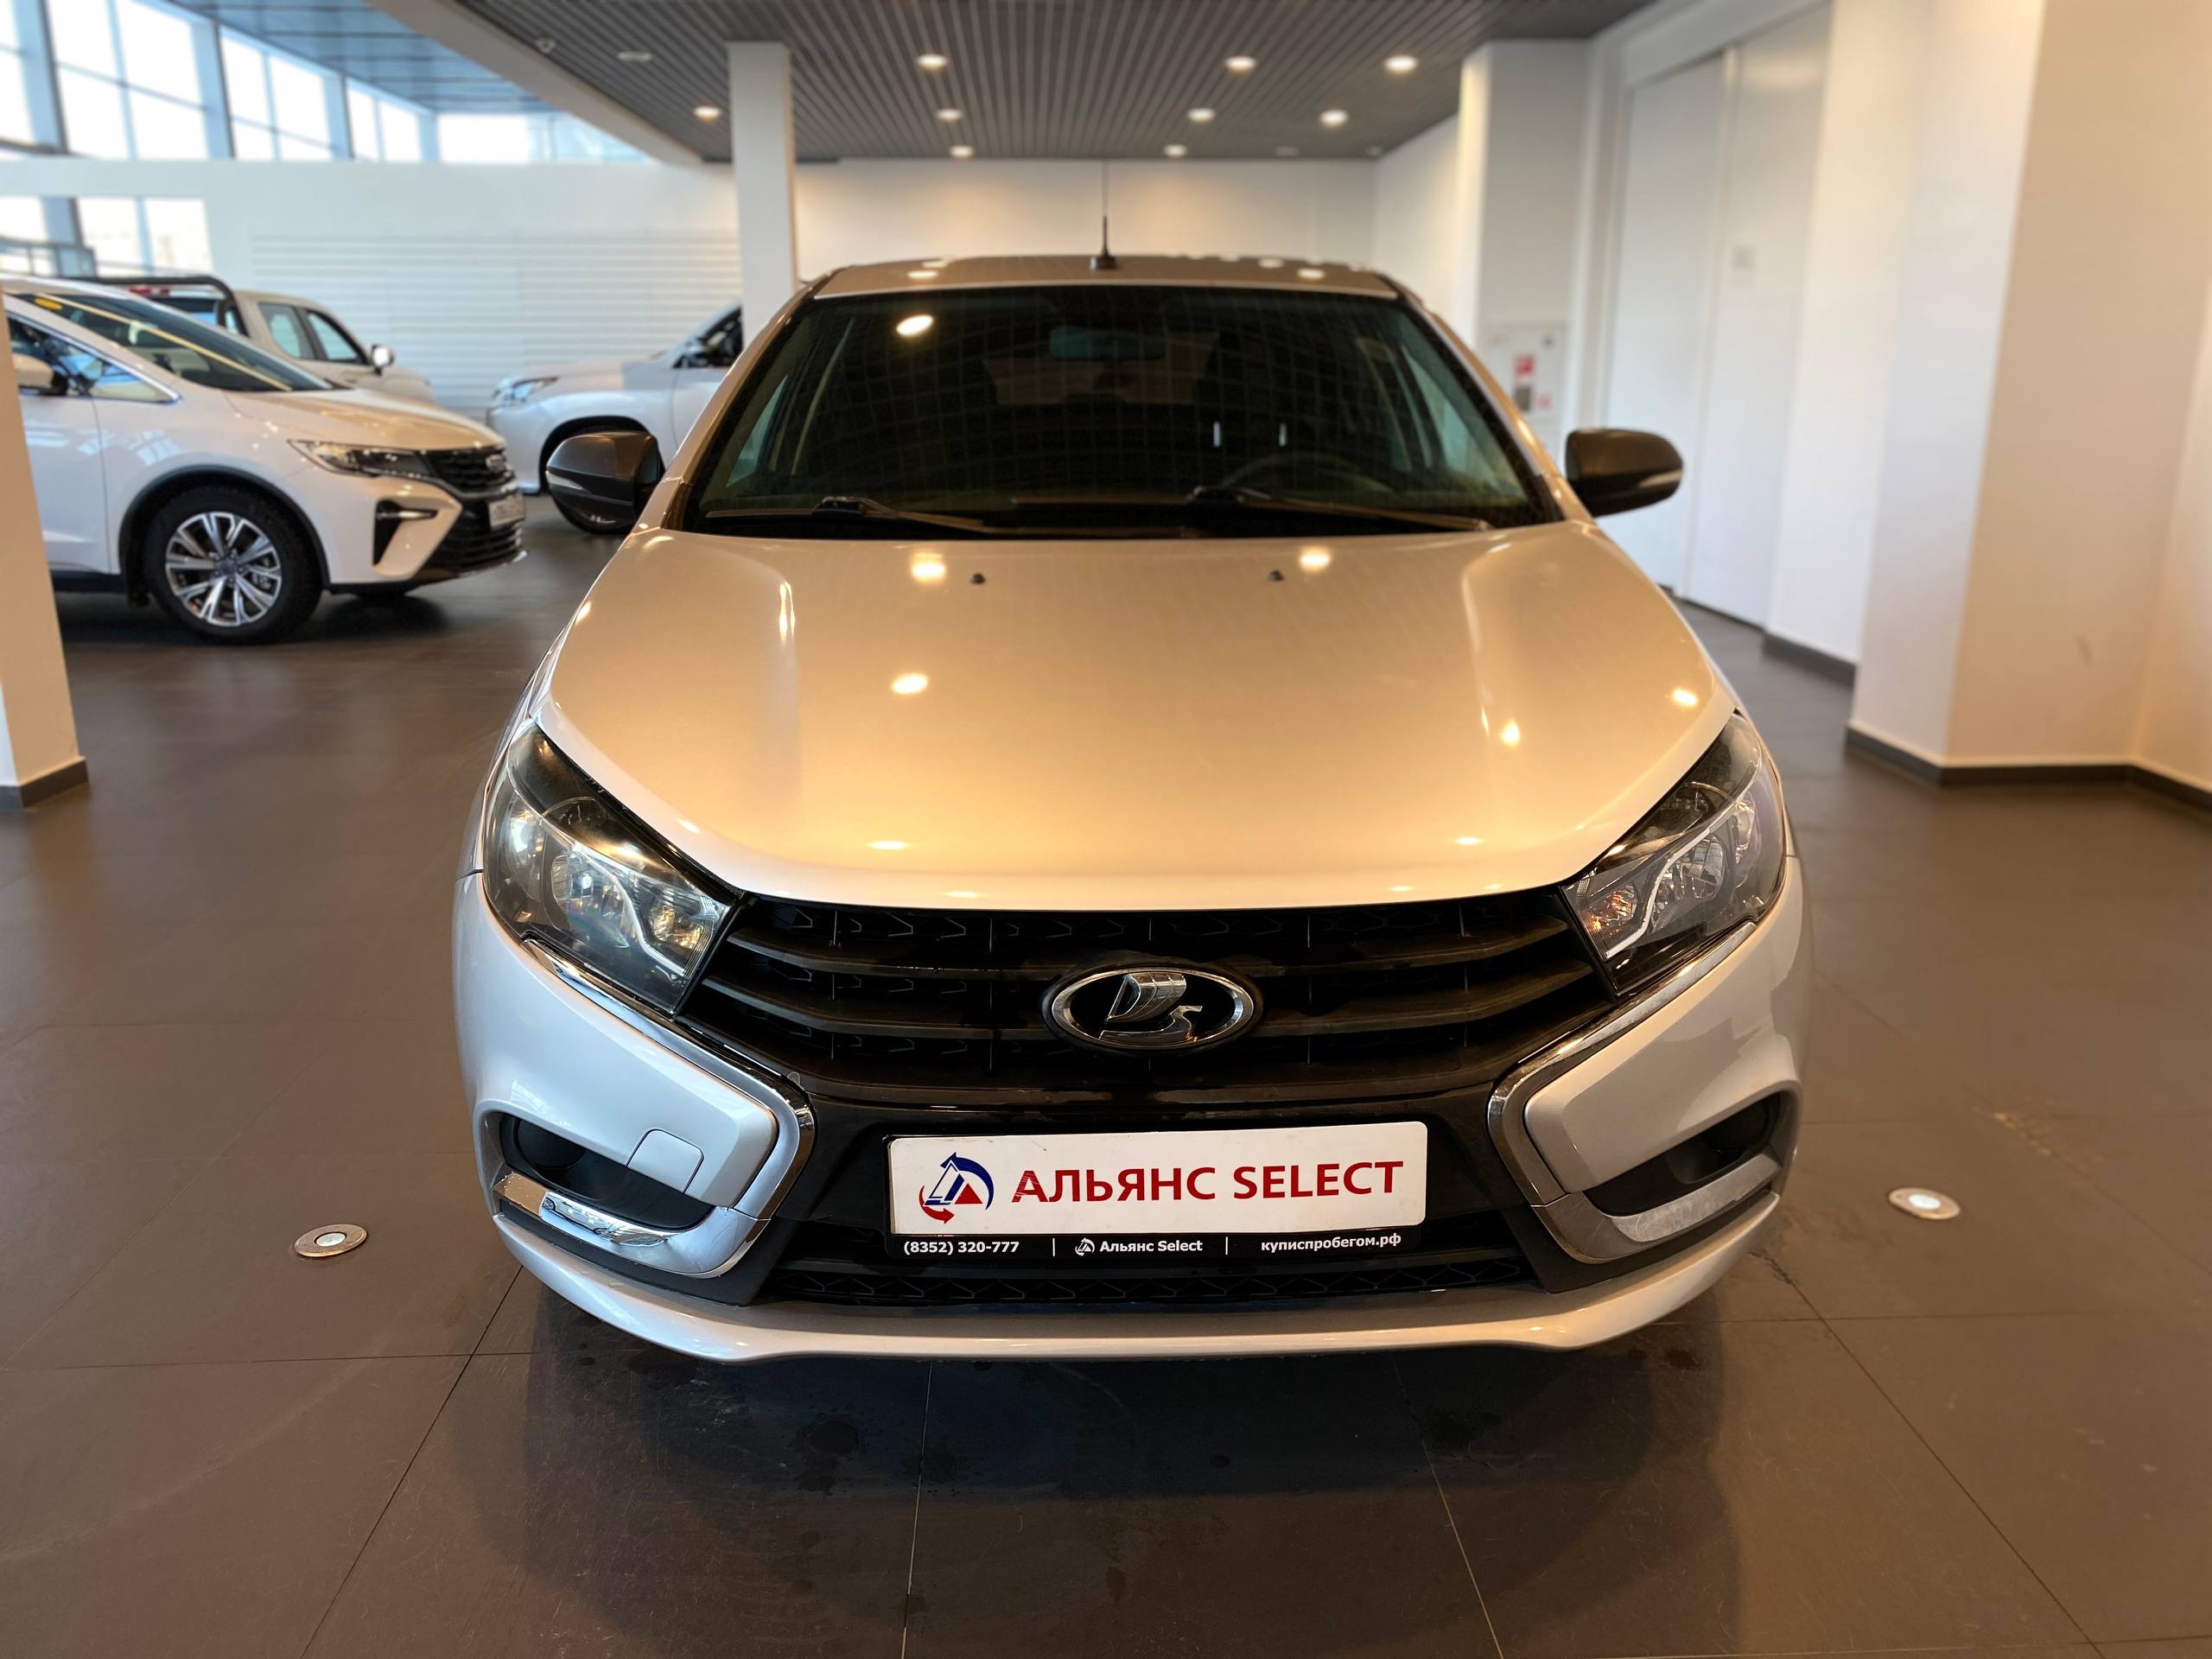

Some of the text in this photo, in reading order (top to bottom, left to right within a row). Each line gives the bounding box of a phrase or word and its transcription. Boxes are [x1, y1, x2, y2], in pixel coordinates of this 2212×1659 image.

[1012, 1160, 1404, 1203] АЛЬЯНС SELECT
[903, 1241, 1020, 1255] (8352) 320-777
[1099, 1239, 1204, 1252] Альянс Select
[1261, 1232, 1402, 1253] куписпробегом.рф
